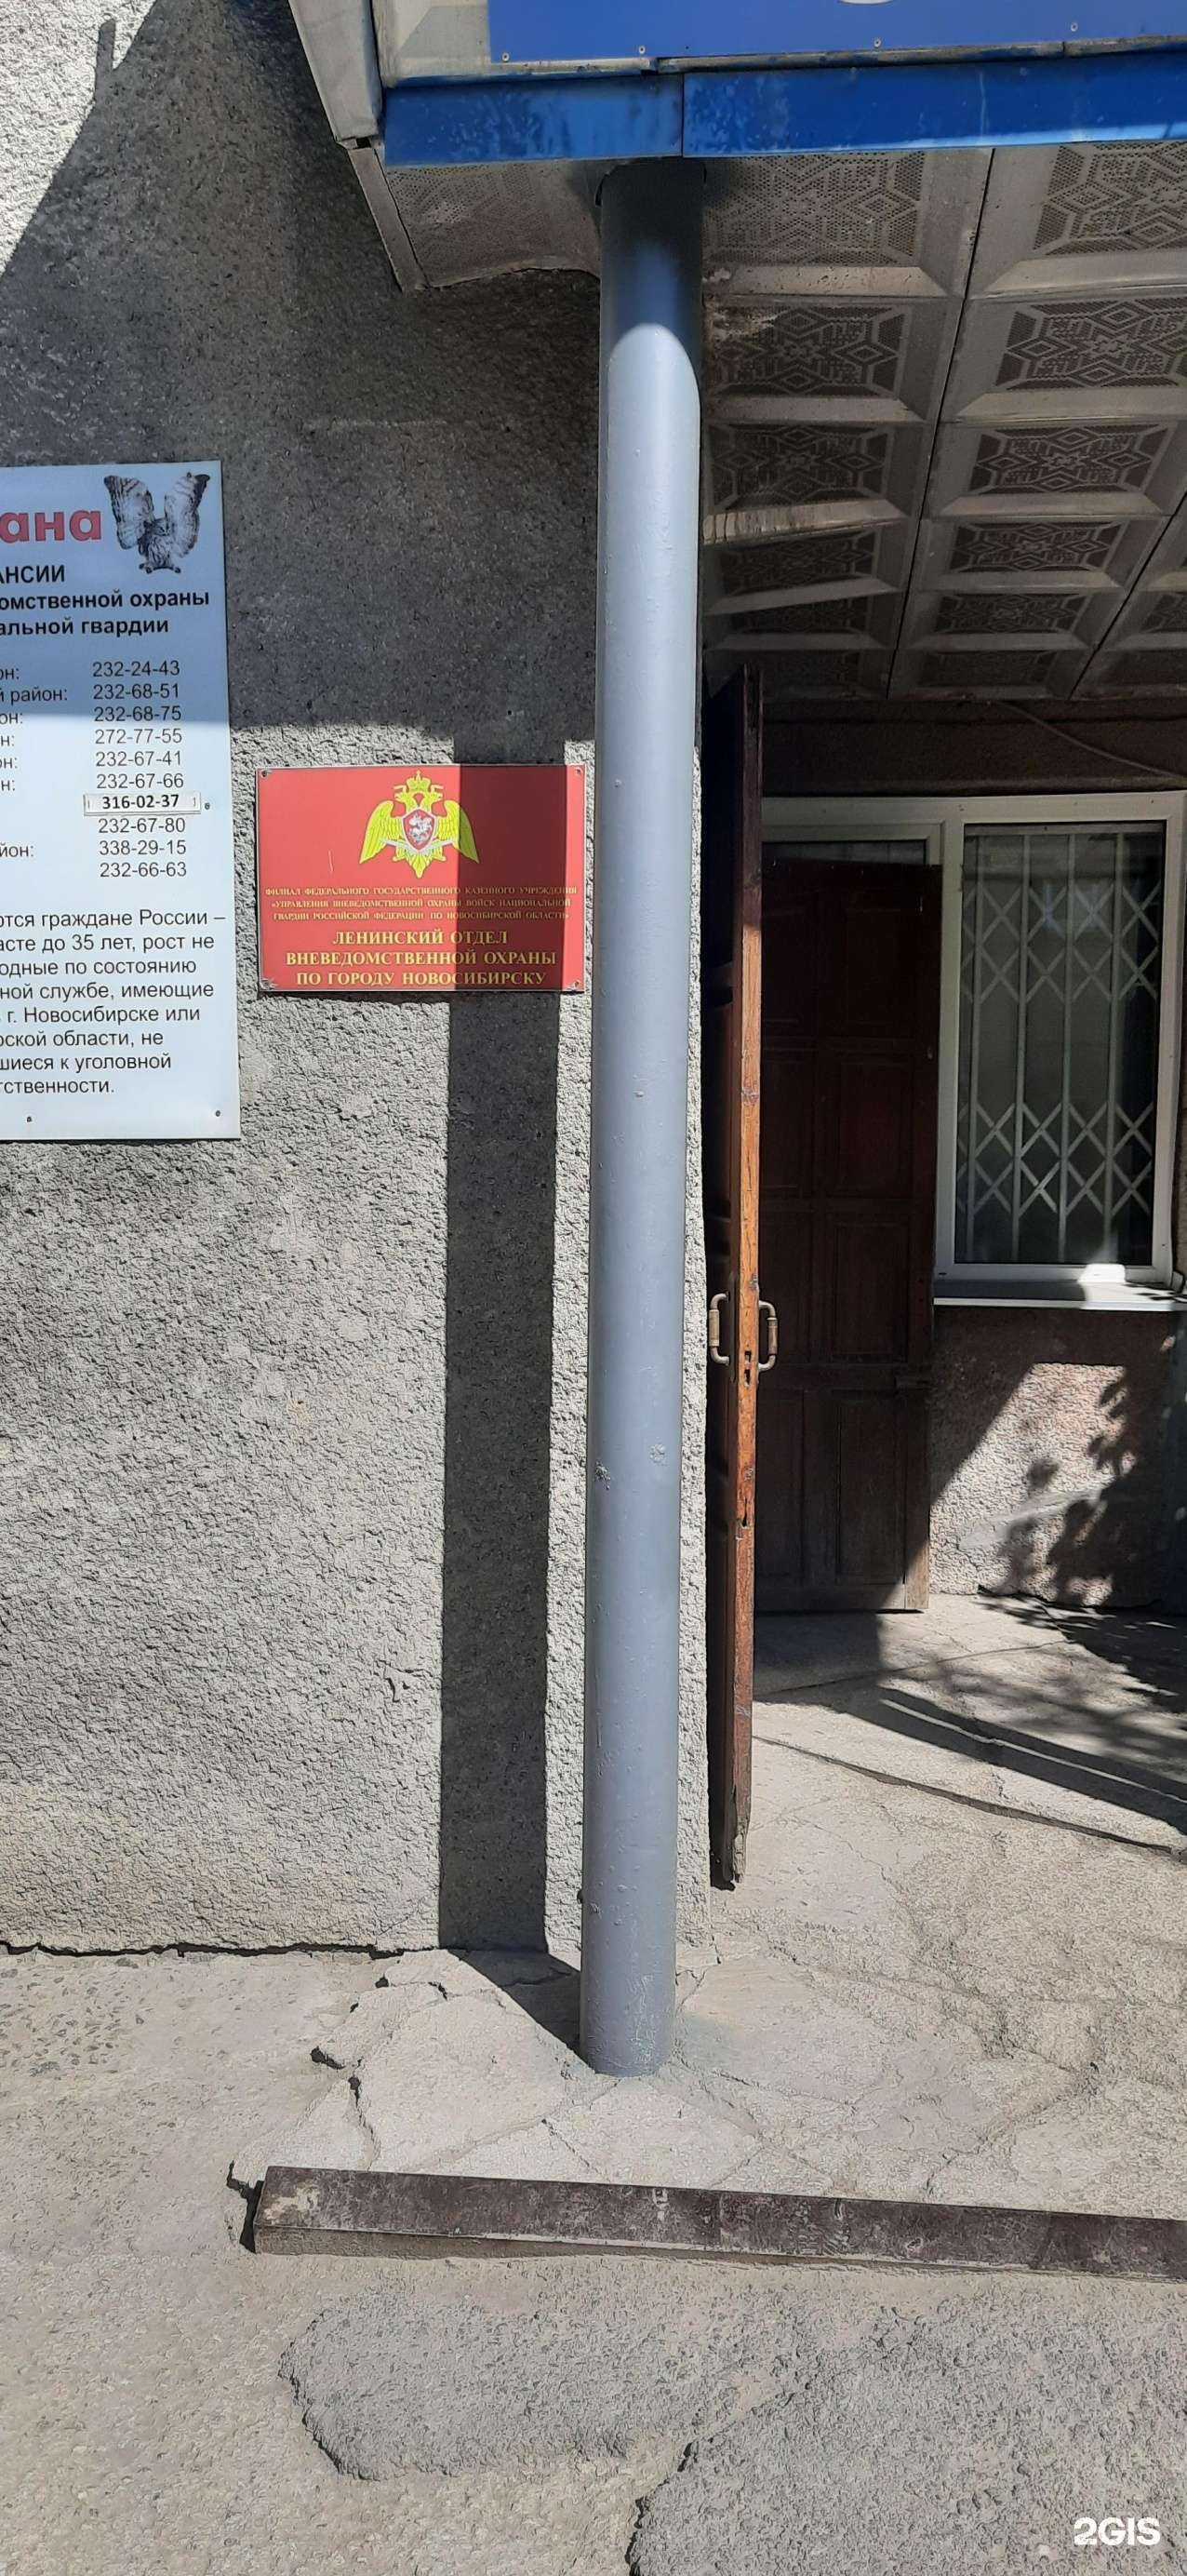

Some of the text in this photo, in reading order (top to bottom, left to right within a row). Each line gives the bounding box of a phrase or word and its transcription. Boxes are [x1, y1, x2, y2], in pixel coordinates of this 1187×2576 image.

[129, 591, 209, 610] охраны
[81, 618, 168, 637] гвардии
[93, 660, 180, 678] 232-24-43
[10, 687, 68, 704] район:
[93, 683, 180, 699] 232-68-51
[94, 705, 181, 722] 232-68-75
[95, 728, 182, 745] 272-77-55
[96, 751, 180, 767] 232-67-41
[97, 773, 184, 789] 232-67-66
[102, 795, 179, 809] 316-02-37
[98, 817, 185, 834] 232-67-80
[99, 839, 186, 855] 338-29-15
[100, 862, 187, 878] 232-66-63
[265, 887, 300, 895] ФИЛИАЛ
[304, 887, 369, 895] ФЕДЕРАЛЬНОГО
[373, 887, 460, 895] ГОСУДАРСТВЕННОГО
[465, 886, 515, 894] КАЗЕННОГО
[333, 898, 423, 908] ВНЕВЕДОМСТВЕННОЙ
[427, 899, 461, 907] ОХРАНЫ
[466, 897, 495, 907] ВОЙСК
[499, 897, 571, 907] НАЦИОНАЛЬНОЙ
[42, 913, 132, 931] граждане
[140, 909, 207, 925] России
[313, 910, 369, 920] РОССИЙСКОЙ
[374, 912, 423, 920] ФЕДЕРАЦИИ
[447, 910, 521, 919] НОВОСИБИРСКОЙ
[42, 938, 65, 953] до
[72, 934, 94, 950] 35
[100, 937, 136, 952] лет,
[143, 936, 185, 953] рост
[193, 936, 214, 949] не
[333, 929, 508, 946] ЛЕНИНСКИЙ ОТДЕЛ
[286, 948, 556, 967] ВНЕВЕДОМСТВЕННОЙ ОХРАНЫ
[65, 961, 87, 974] по
[93, 960, 196, 974] состоянию
[297, 972, 547, 986] ПО ГОРОДУ НОВОСИБИРСКУ
[40, 982, 113, 1002] службе,
[121, 984, 214, 1000] имеющие
[7, 1006, 200, 1025] г. Новосибирске или
[53, 1029, 134, 1047] области,
[141, 1032, 164, 1045] не
[60, 1057, 69, 1069] к
[75, 1053, 171, 1073] уголовной
[0, 1080, 114, 1093] ственности.
